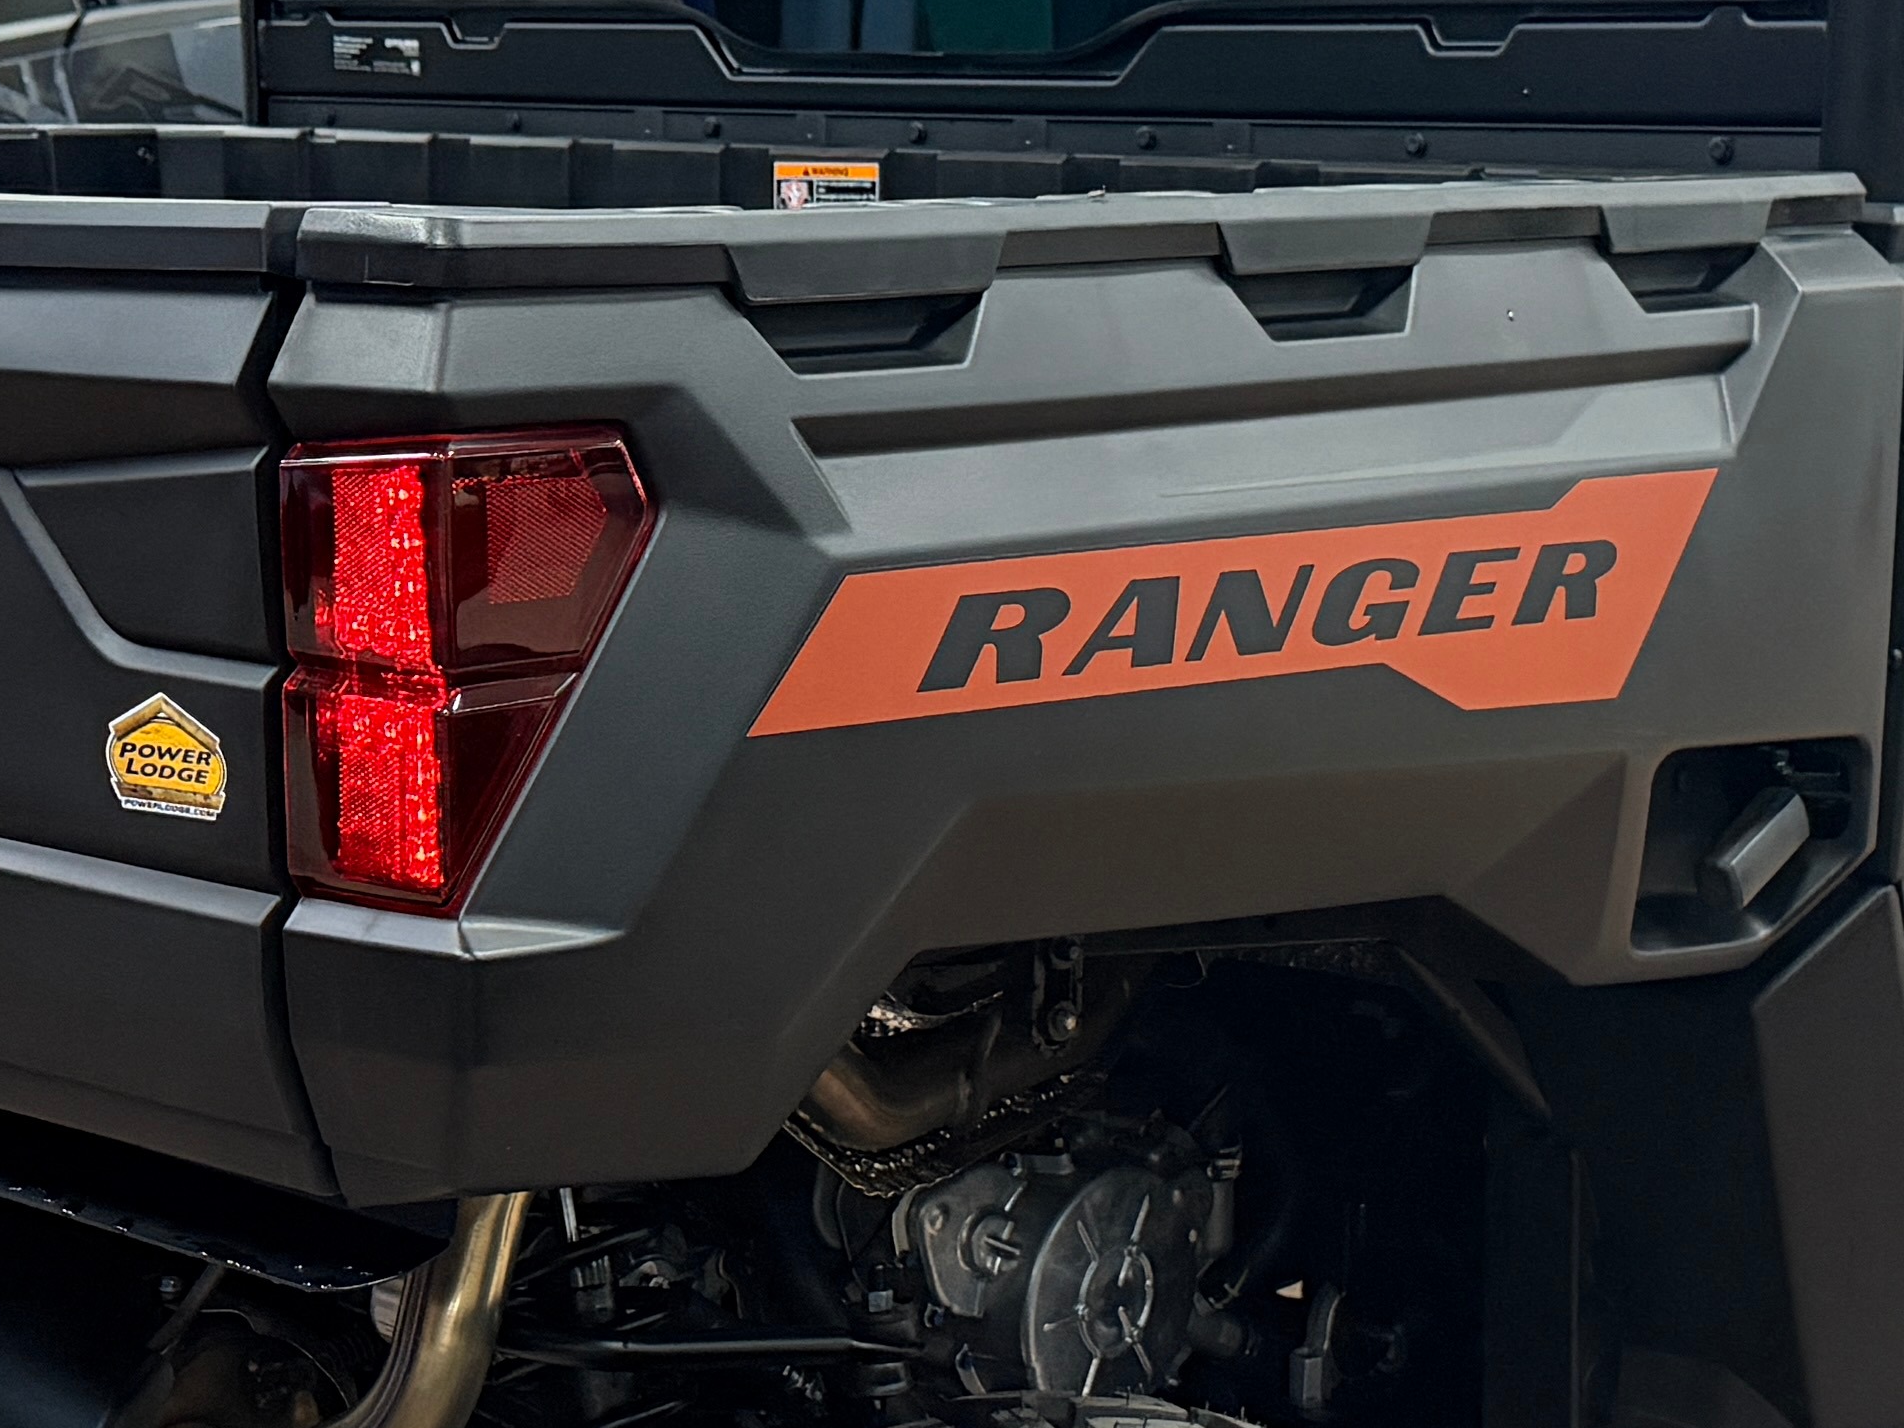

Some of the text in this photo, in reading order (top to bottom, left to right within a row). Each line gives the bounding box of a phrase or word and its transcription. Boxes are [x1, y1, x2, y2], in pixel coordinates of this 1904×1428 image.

[916, 539, 1618, 692] RANGER
[119, 742, 212, 766] POWER
[125, 757, 210, 785] LODGE
